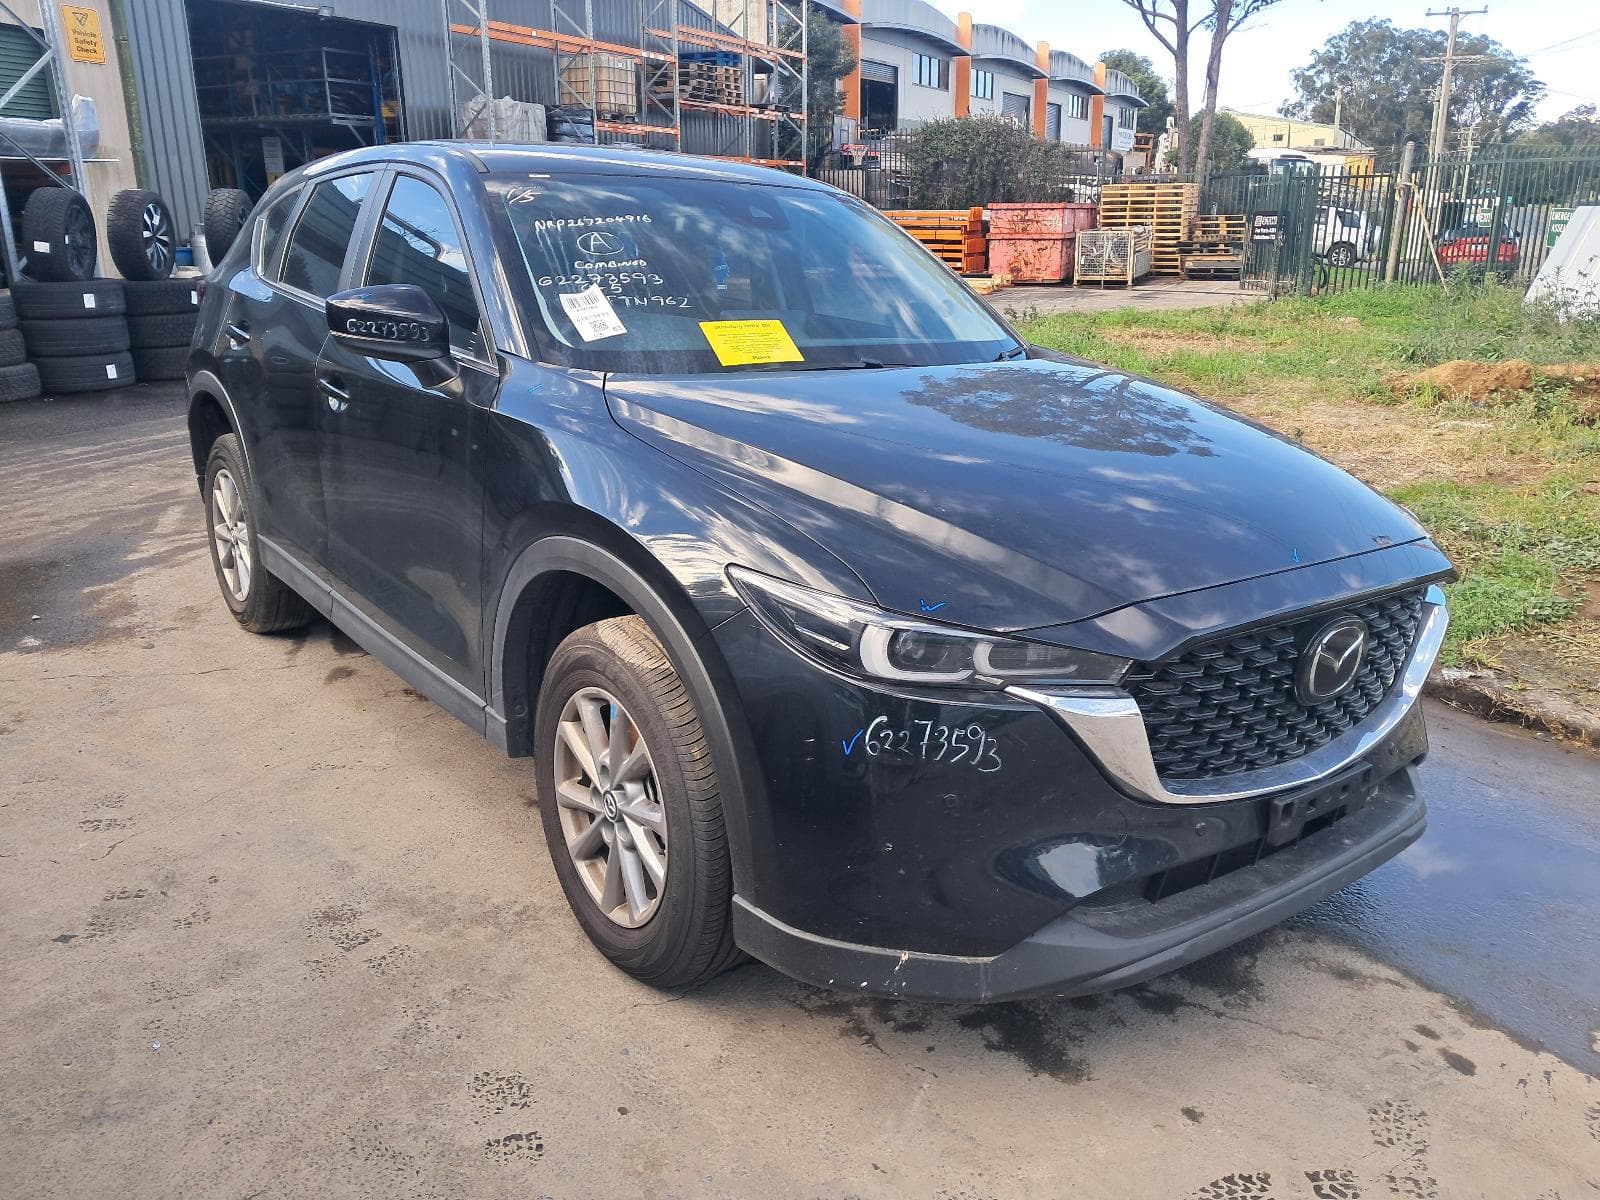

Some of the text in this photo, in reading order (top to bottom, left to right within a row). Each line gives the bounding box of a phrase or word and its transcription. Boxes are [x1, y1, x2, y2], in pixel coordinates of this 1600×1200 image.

[71, 28, 97, 38] Vehicle
[74, 37, 97, 47] Safety
[76, 45, 98, 55] Check
[590, 231, 612, 252] A
[865, 715, 1002, 772] 62273593
